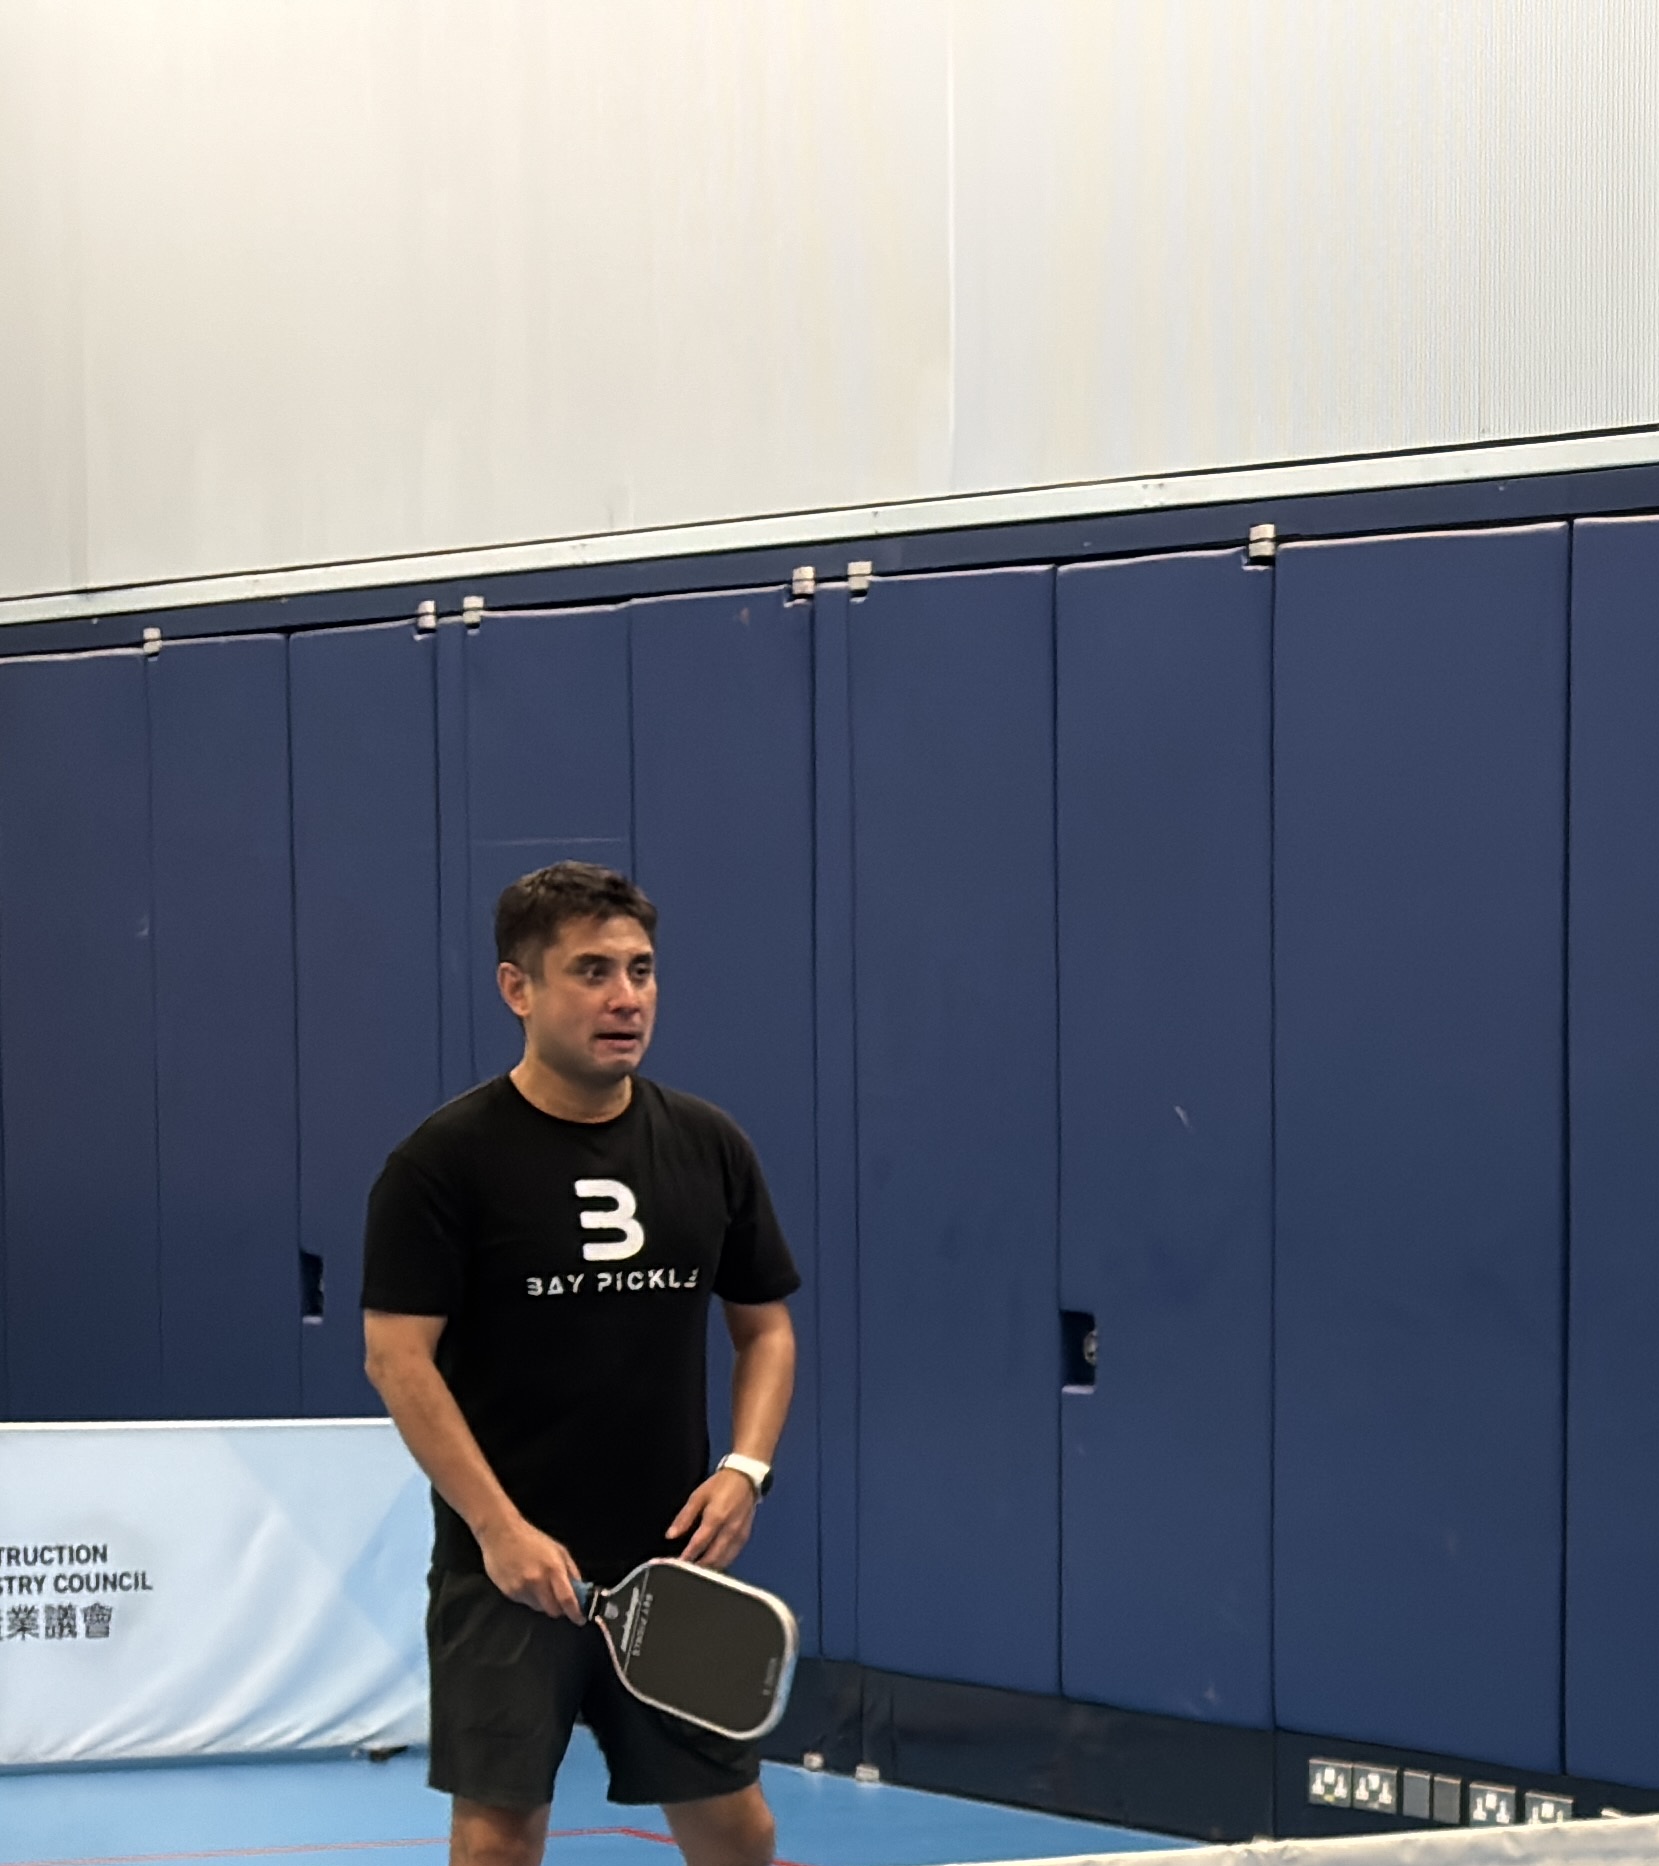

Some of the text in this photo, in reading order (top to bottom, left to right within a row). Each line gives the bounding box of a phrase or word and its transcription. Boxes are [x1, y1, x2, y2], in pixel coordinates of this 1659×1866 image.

[0, 1570, 153, 1596] TRY COUNCIL
[0, 1602, 113, 1641] 業議會
